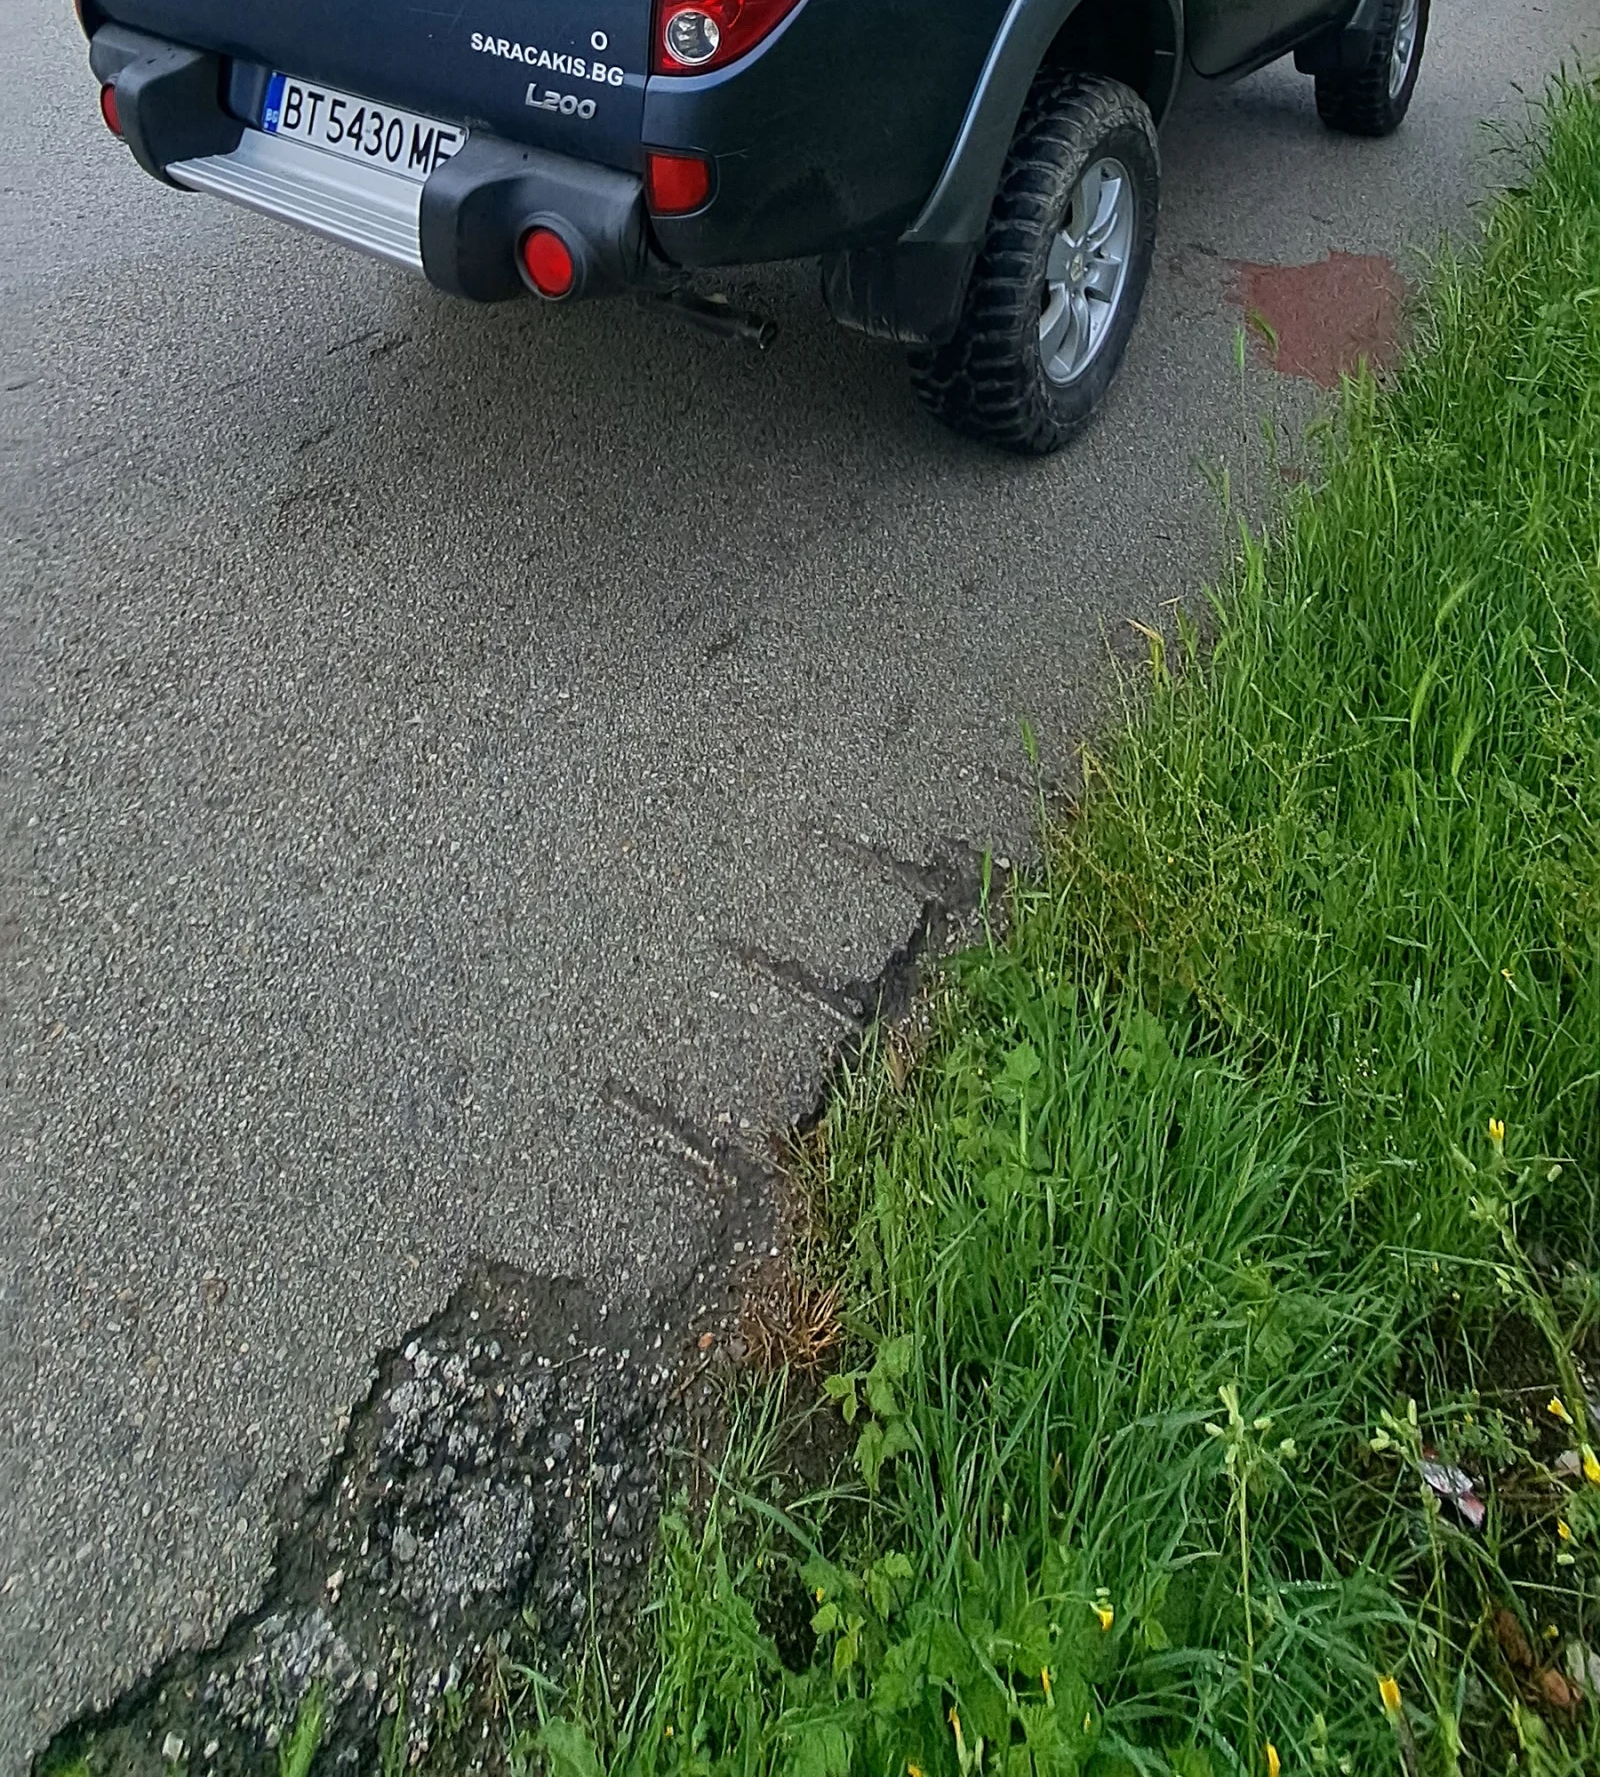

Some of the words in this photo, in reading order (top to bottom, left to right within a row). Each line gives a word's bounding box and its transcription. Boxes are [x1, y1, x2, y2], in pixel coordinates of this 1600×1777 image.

[470, 32, 625, 87] SARACAKIS.BG
[265, 107, 280, 124] BG
[282, 85, 325, 136] BT
[326, 98, 405, 163] 5430
[525, 82, 597, 120] L200
